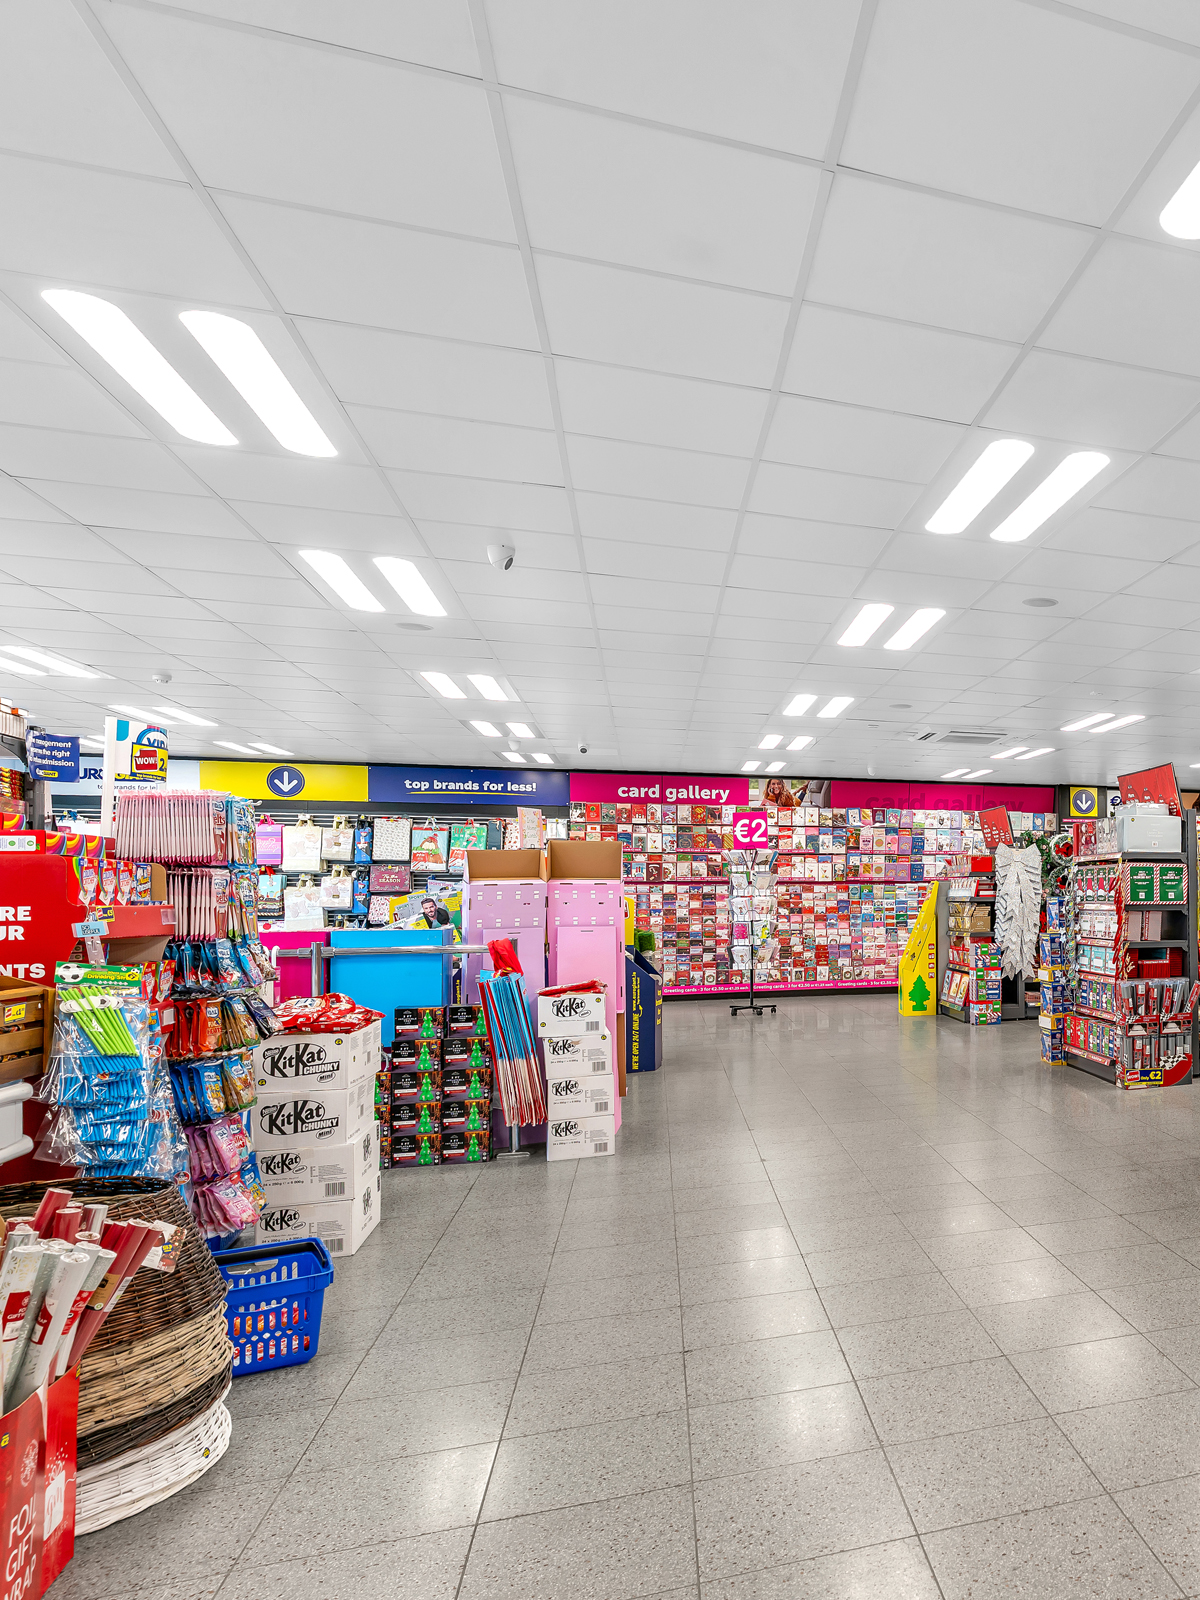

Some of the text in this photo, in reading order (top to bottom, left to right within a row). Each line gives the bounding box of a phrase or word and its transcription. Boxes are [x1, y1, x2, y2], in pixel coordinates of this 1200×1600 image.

[51, 750, 70, 758] right
[404, 779, 536, 792] top brands for less!
[617, 784, 730, 802] card gallery
[865, 793, 926, 810] card
[733, 819, 766, 842] €2
[556, 998, 584, 1017] KitKat
[552, 1039, 574, 1055] KitKa
[270, 1043, 324, 1078] KitKat
[303, 1061, 339, 1075] CHUNKY
[320, 1072, 333, 1081] Mini
[1149, 1071, 1161, 1079] €2
[554, 1080, 578, 1096] KitKat
[269, 1100, 322, 1135] KitKat
[302, 1118, 338, 1132] CHUNKY
[318, 1129, 332, 1138] Mini
[554, 1121, 577, 1137] KitKat
[266, 1153, 299, 1175] KitKat
[265, 1209, 298, 1231] KitKat
[8, 1493, 37, 1548] FOIL
[6, 1524, 36, 1582] GIFT
